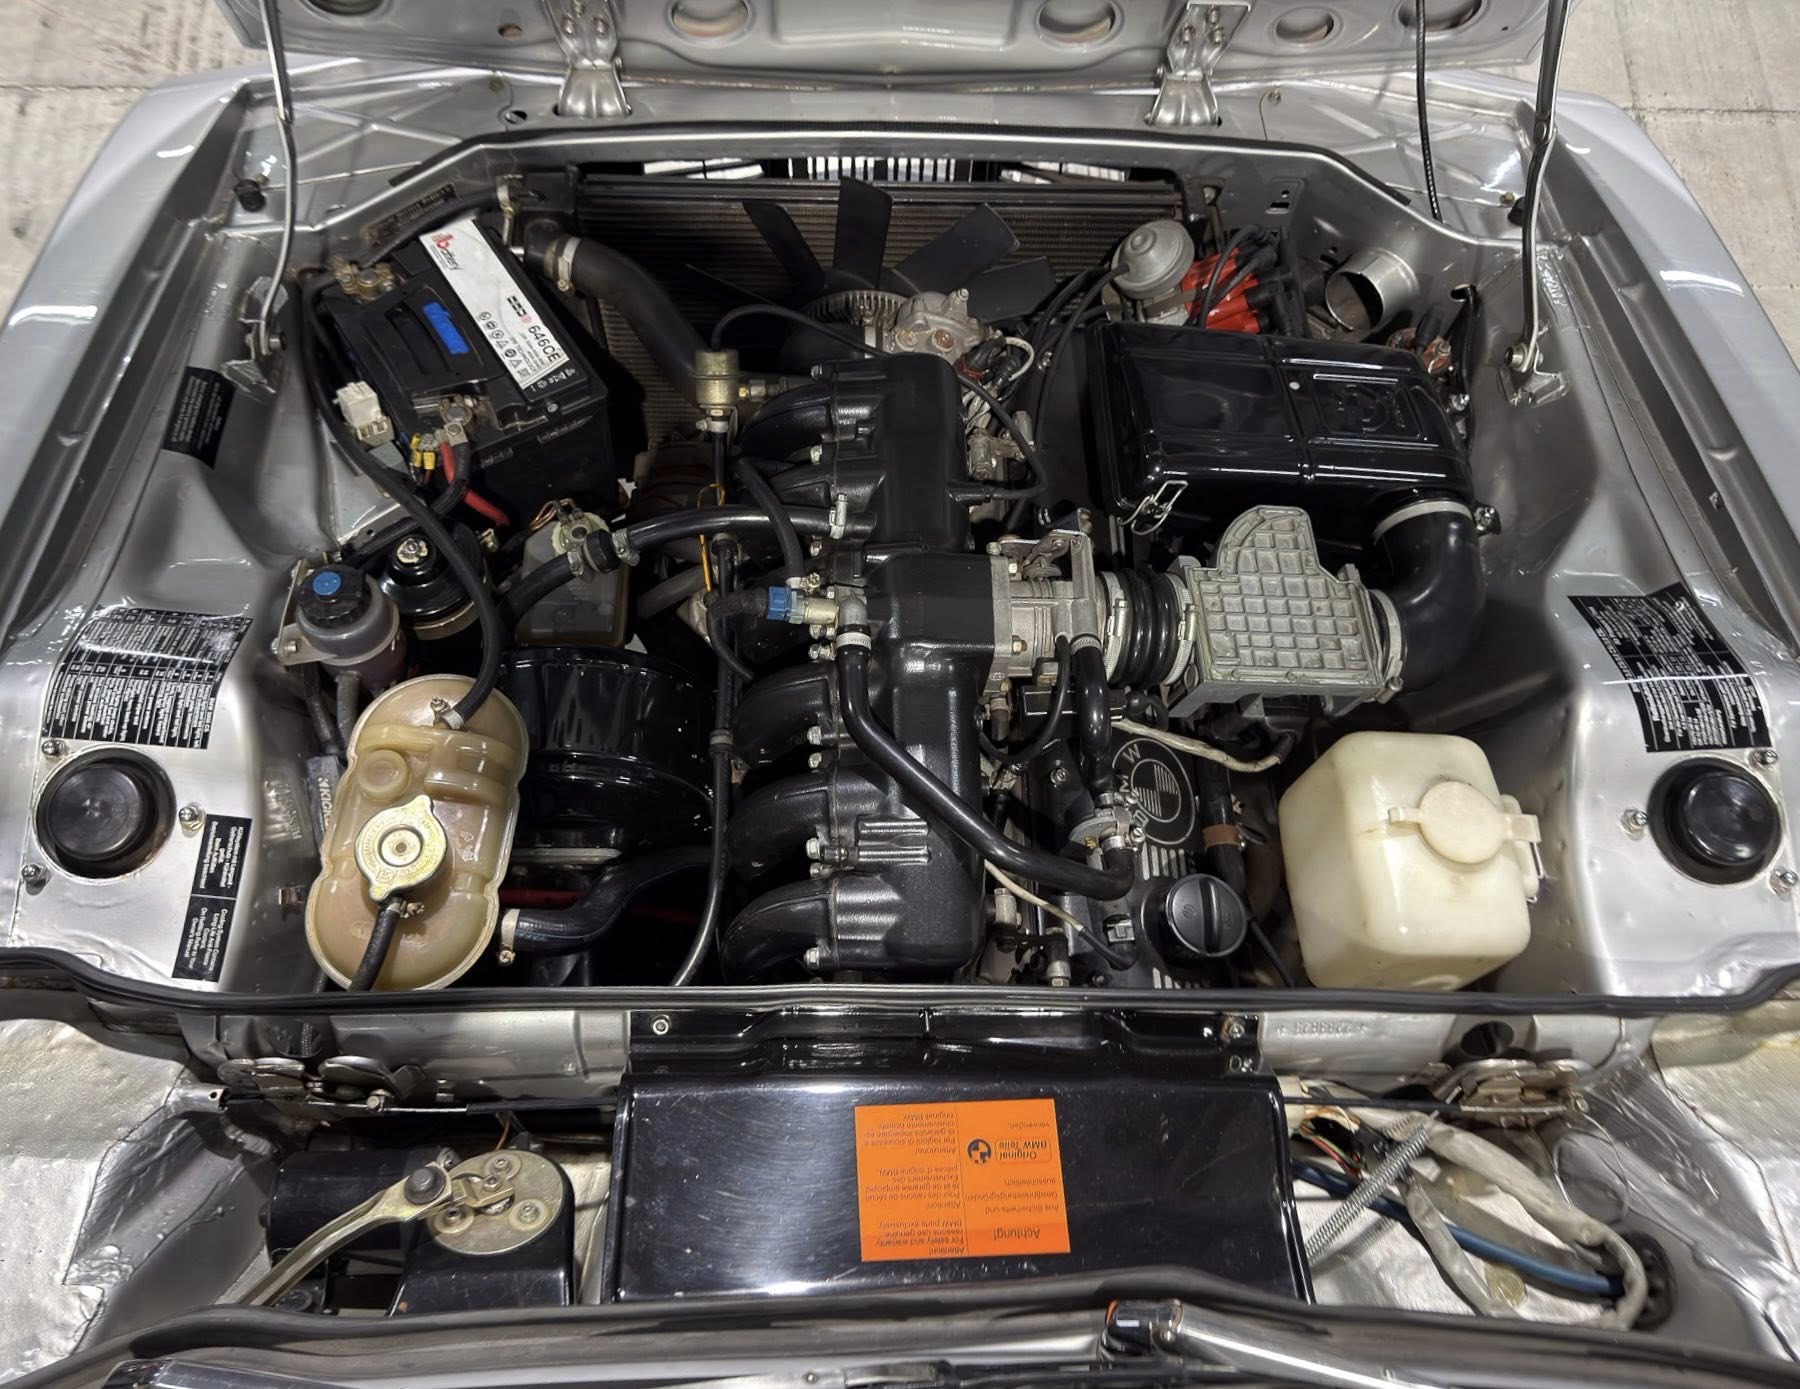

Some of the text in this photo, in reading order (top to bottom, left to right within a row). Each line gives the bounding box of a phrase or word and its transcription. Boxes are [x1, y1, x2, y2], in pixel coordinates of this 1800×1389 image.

[527, 322, 560, 364] 646CE
[207, 696, 215, 710] BMW
[200, 906, 207, 915] On
[217, 908, 227, 929] Cooling
[999, 1140, 1047, 1150] BMW Teile
[1000, 1149, 1037, 1160] Original
[993, 1228, 1040, 1241] Achtung!
